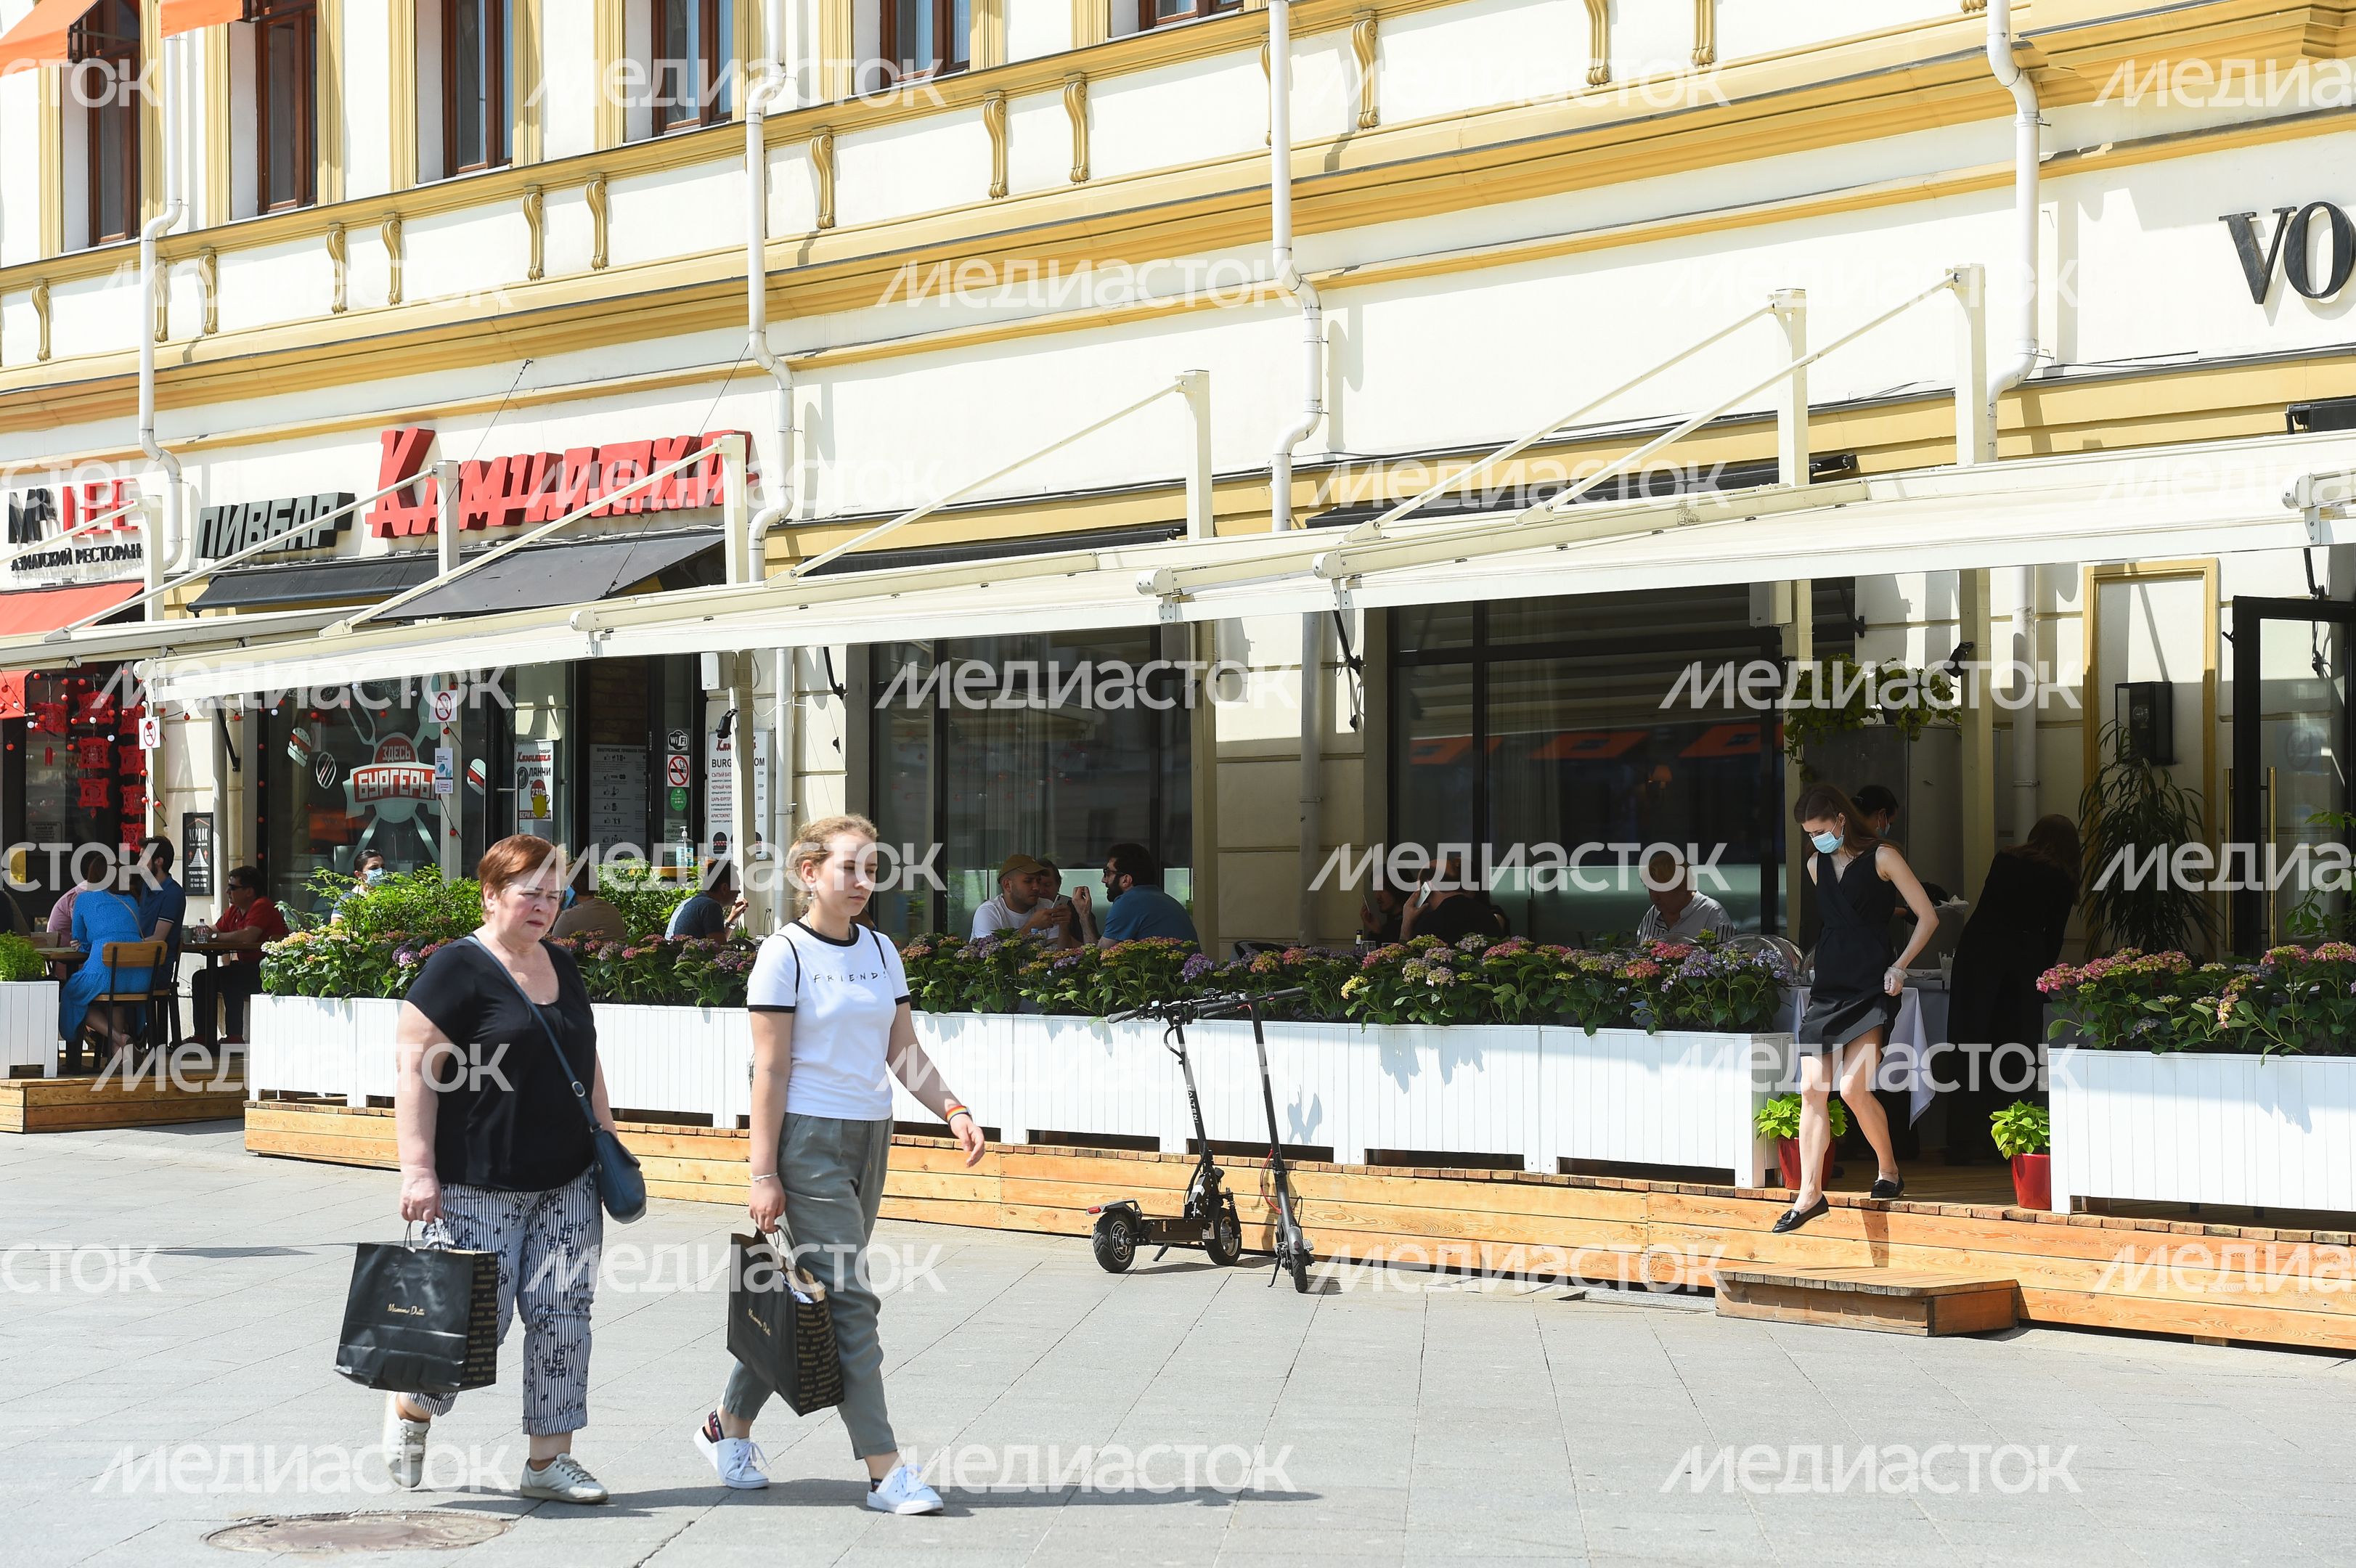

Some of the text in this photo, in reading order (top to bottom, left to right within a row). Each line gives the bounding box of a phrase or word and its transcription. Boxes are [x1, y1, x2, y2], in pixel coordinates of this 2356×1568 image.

[195, 492, 352, 559] ПИВБАР
[11, 543, 142, 571] АЗИАТСКИЙ РЕСТОРАН
[383, 746, 411, 761] ЗДЕСЬ
[358, 769, 436, 799] БУРГЕРЫ
[529, 767, 551, 777] ЛАНЧИ
[1187, 1085, 1198, 1121] HALTEN
